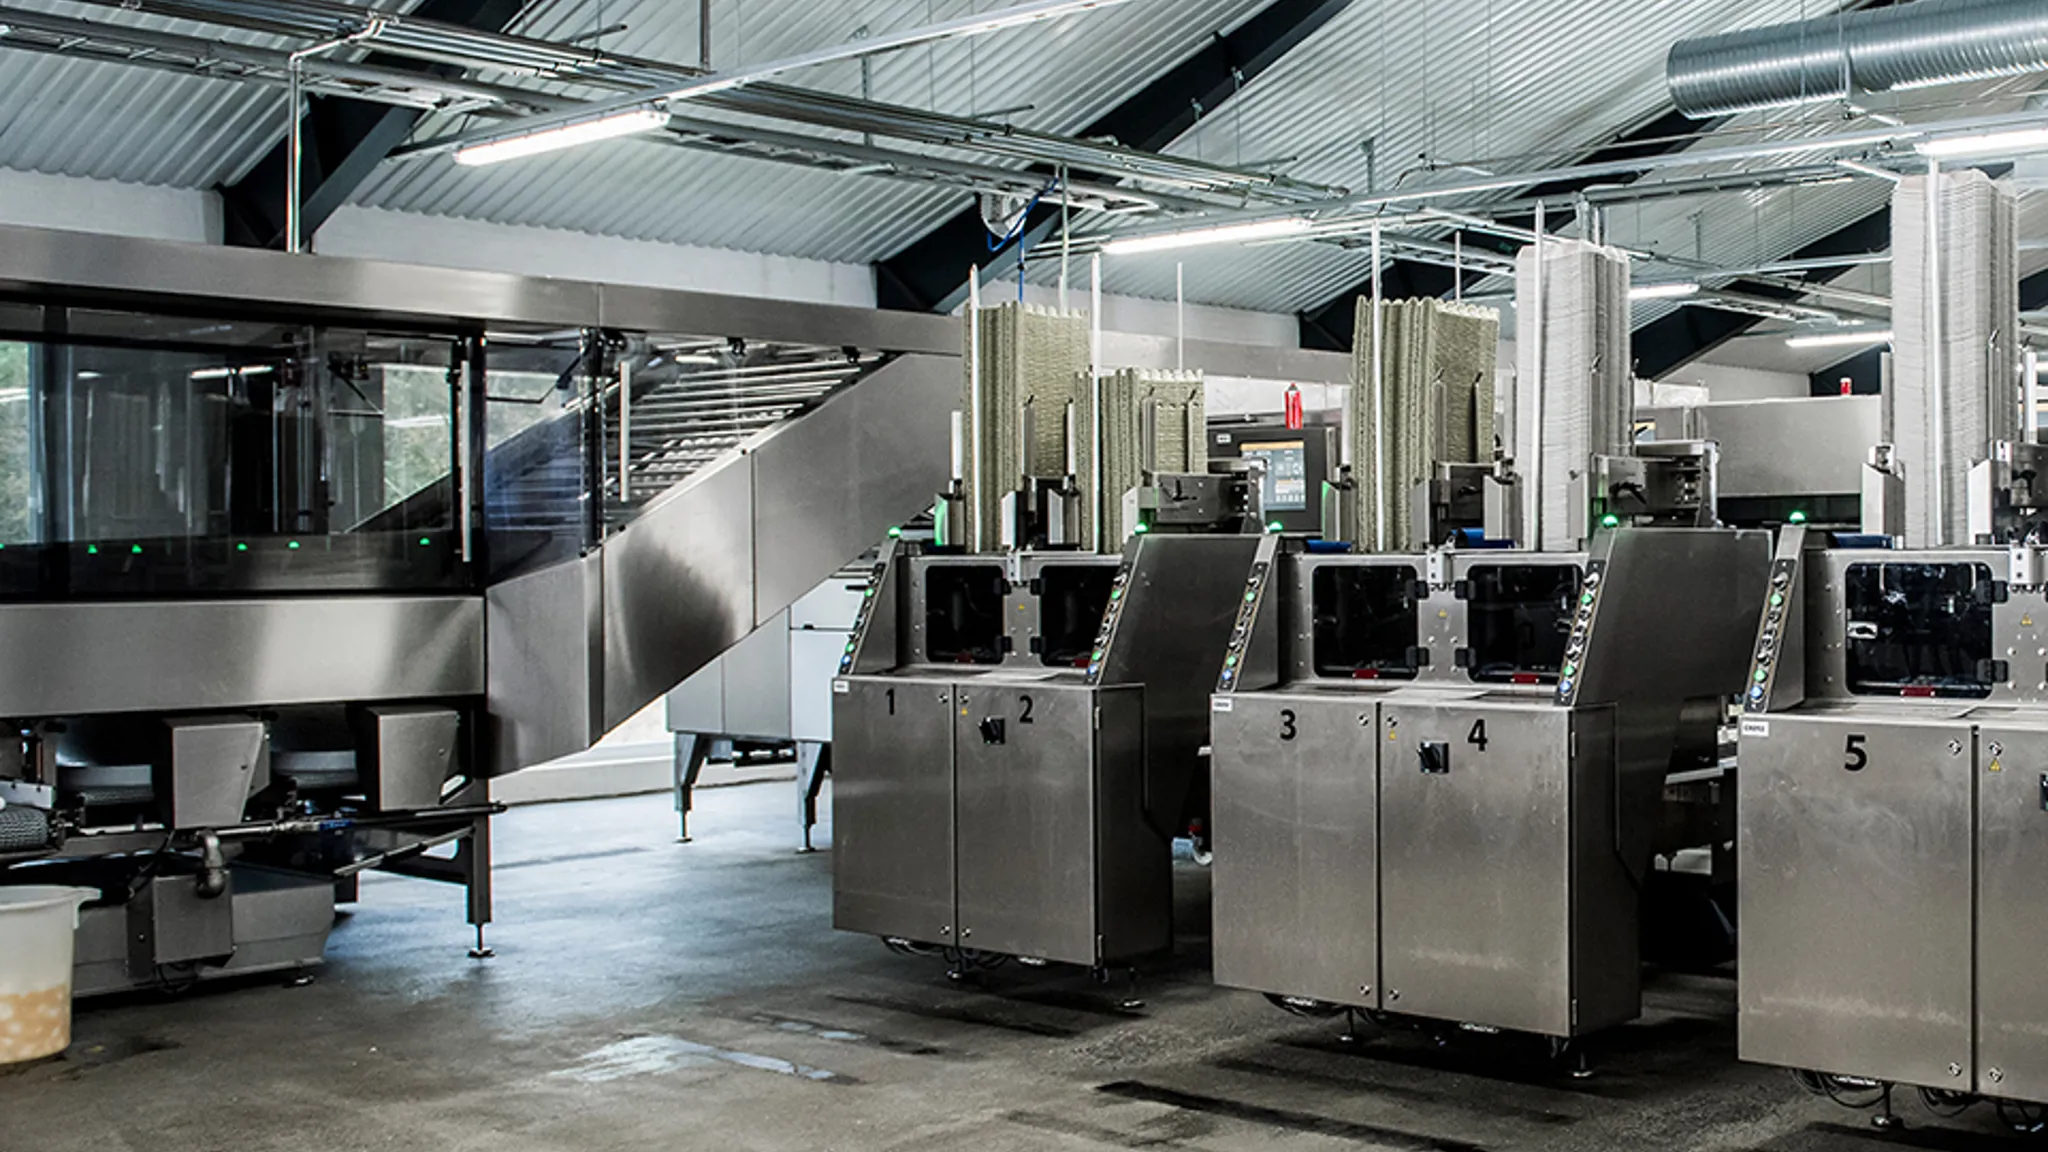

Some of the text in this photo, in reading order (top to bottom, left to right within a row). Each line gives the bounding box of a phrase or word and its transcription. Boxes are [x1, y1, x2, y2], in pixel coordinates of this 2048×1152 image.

[885, 688, 895, 716] 1
[1018, 695, 1034, 724] 2
[1279, 709, 1297, 741] 3
[1467, 718, 1488, 752] 4
[1844, 734, 1868, 772] 5
